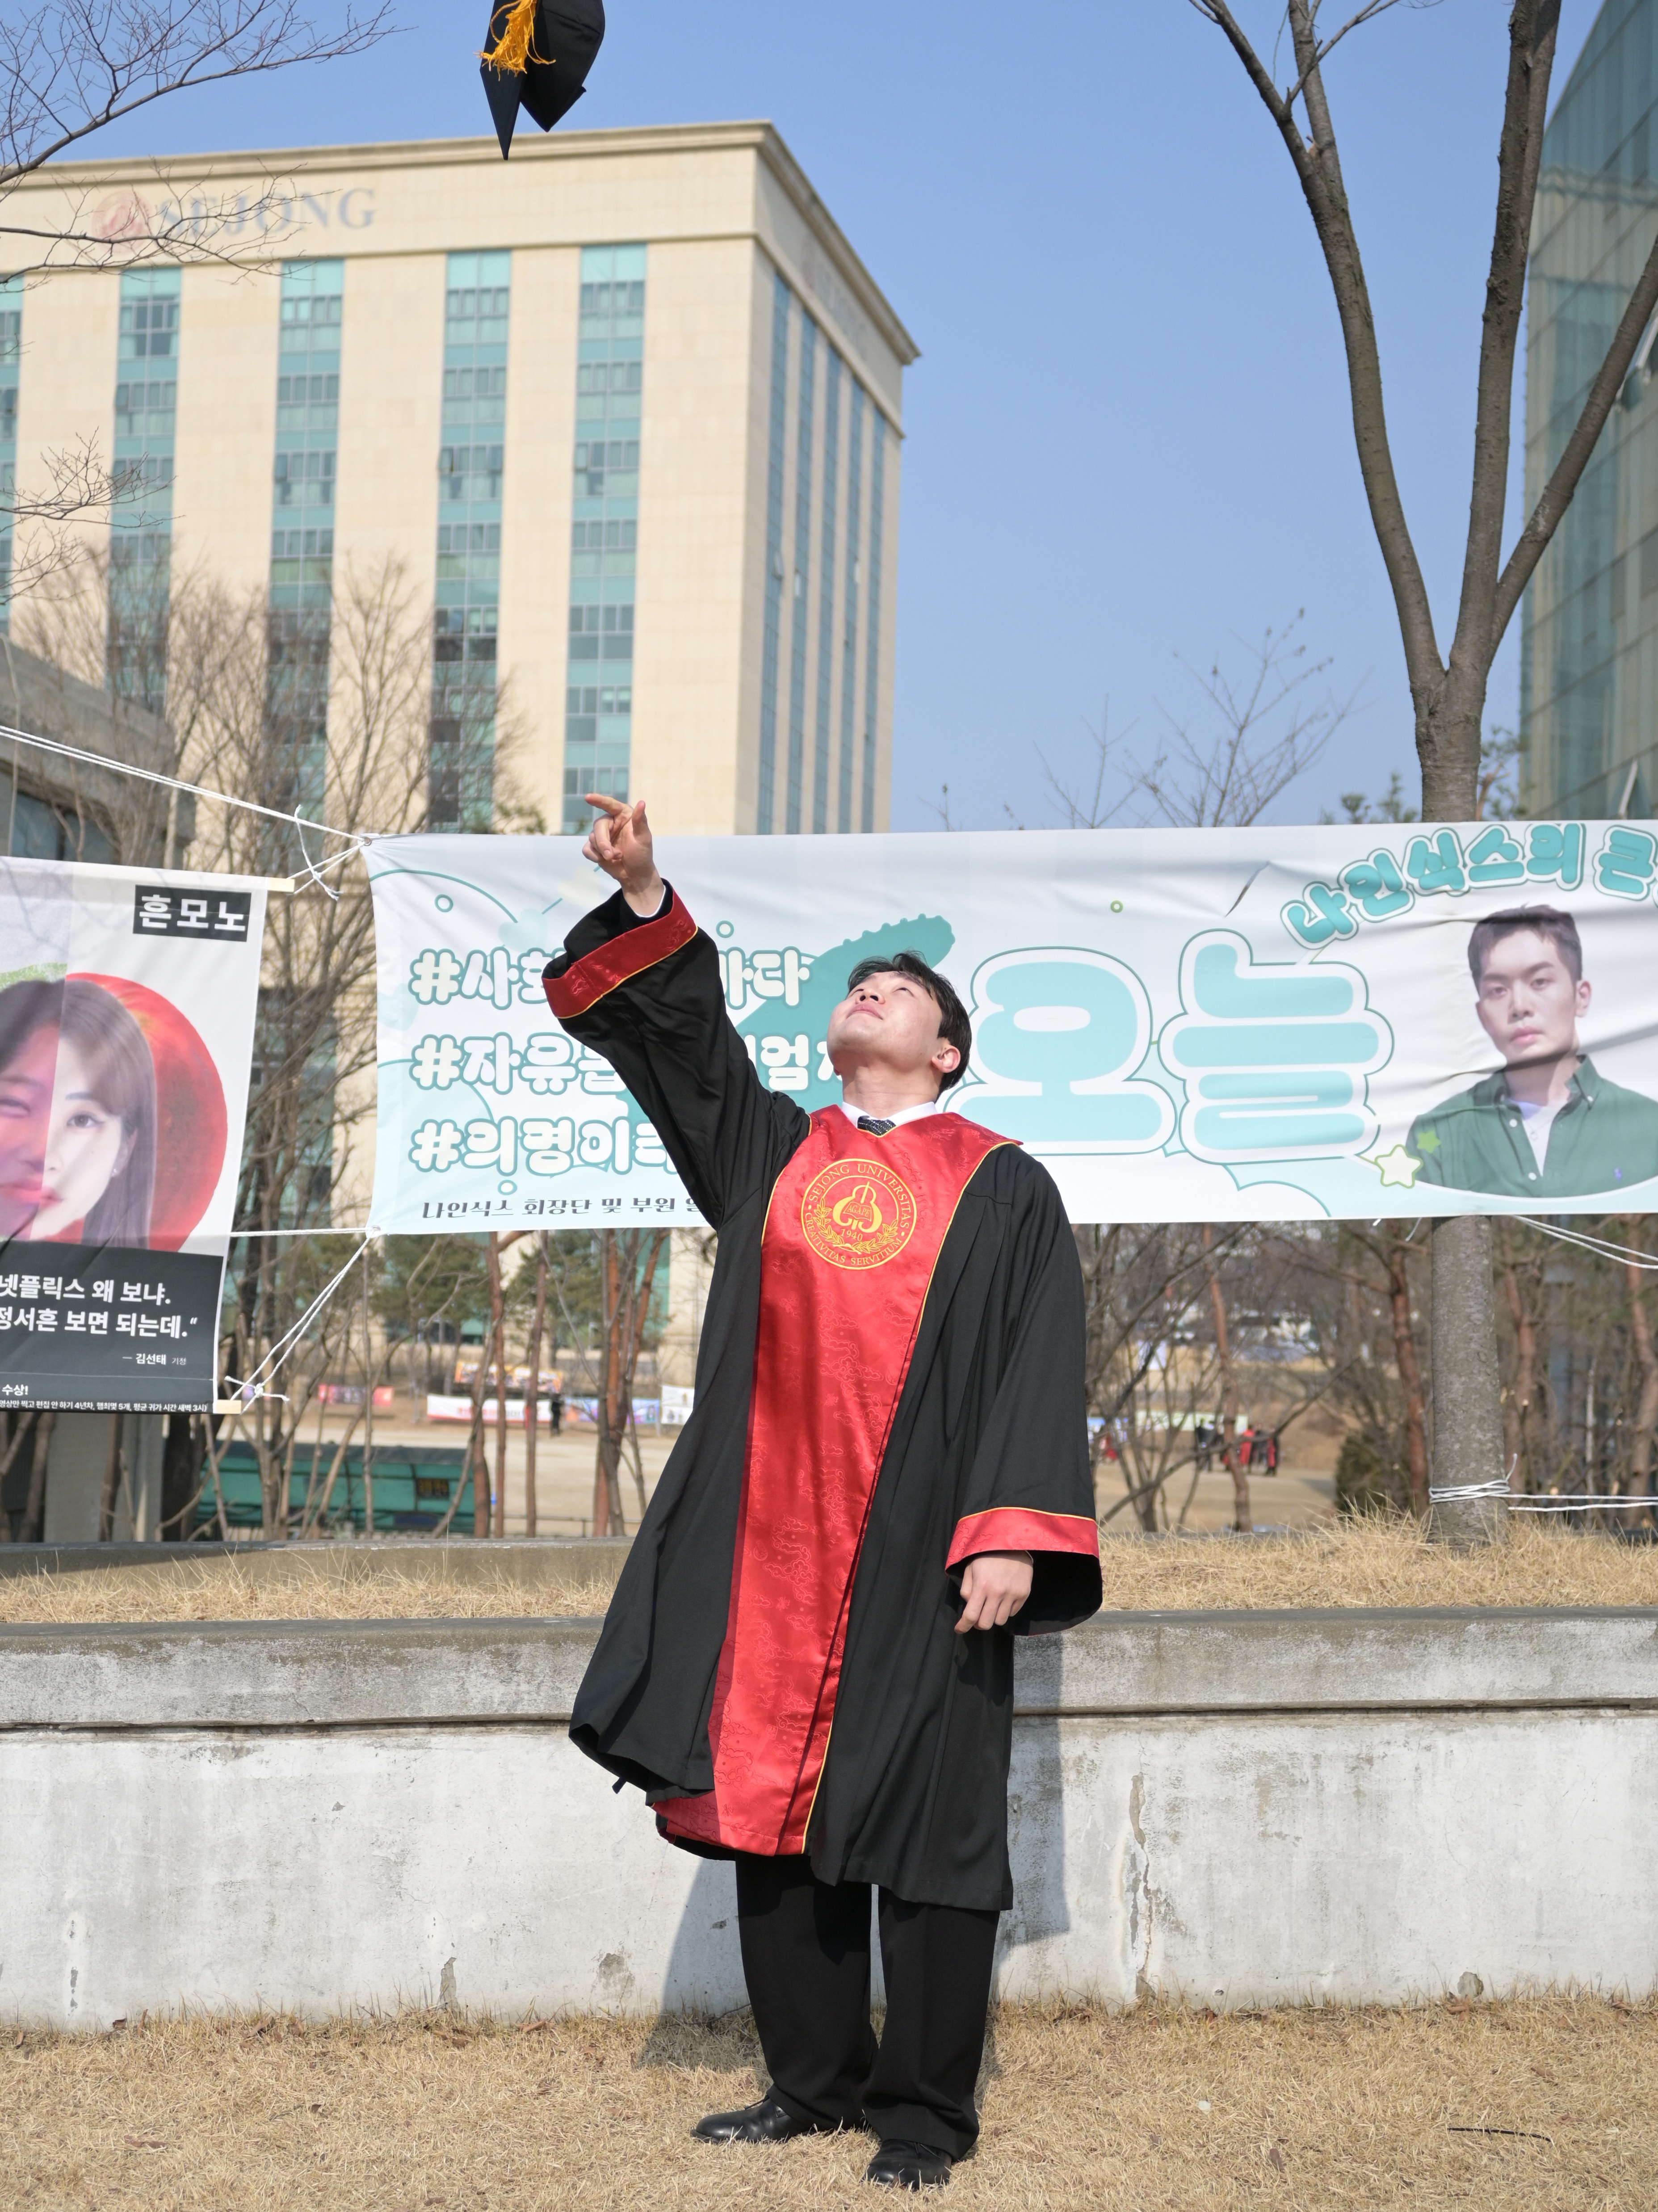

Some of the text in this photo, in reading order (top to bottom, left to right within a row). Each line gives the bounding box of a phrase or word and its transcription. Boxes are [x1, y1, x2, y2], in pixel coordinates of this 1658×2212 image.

[159, 188, 377, 242] SEJONG
[1280, 823, 1658, 949] 나인식스의 큰
[943, 929, 1393, 1164] 오늘
[422, 1199, 514, 1219] 나인식스
[521, 1199, 593, 1215] 회장단
[601, 1198, 622, 1214] 및
[630, 1198, 675, 1212] 부원
[809, 1164, 911, 1229] SEJONG UNIVERSITAS
[848, 1205, 871, 1217] AGAPE
[805, 1212, 902, 1266] CREATIVITAS SERVITIUM
[840, 1229, 863, 1241] 1940
[0, 1274, 171, 1306] 넷플릭스 왜 보냐.
[64, 1310, 109, 1335] 보면
[135, 1353, 167, 1366] 김선태
[1, 1384, 29, 1396] 수상!
[36, 1400, 50, 1409] 편집
[59, 1400, 73, 1410] 하기
[133, 1402, 147, 1412] 평균
[163, 1403, 177, 1412] 시간
